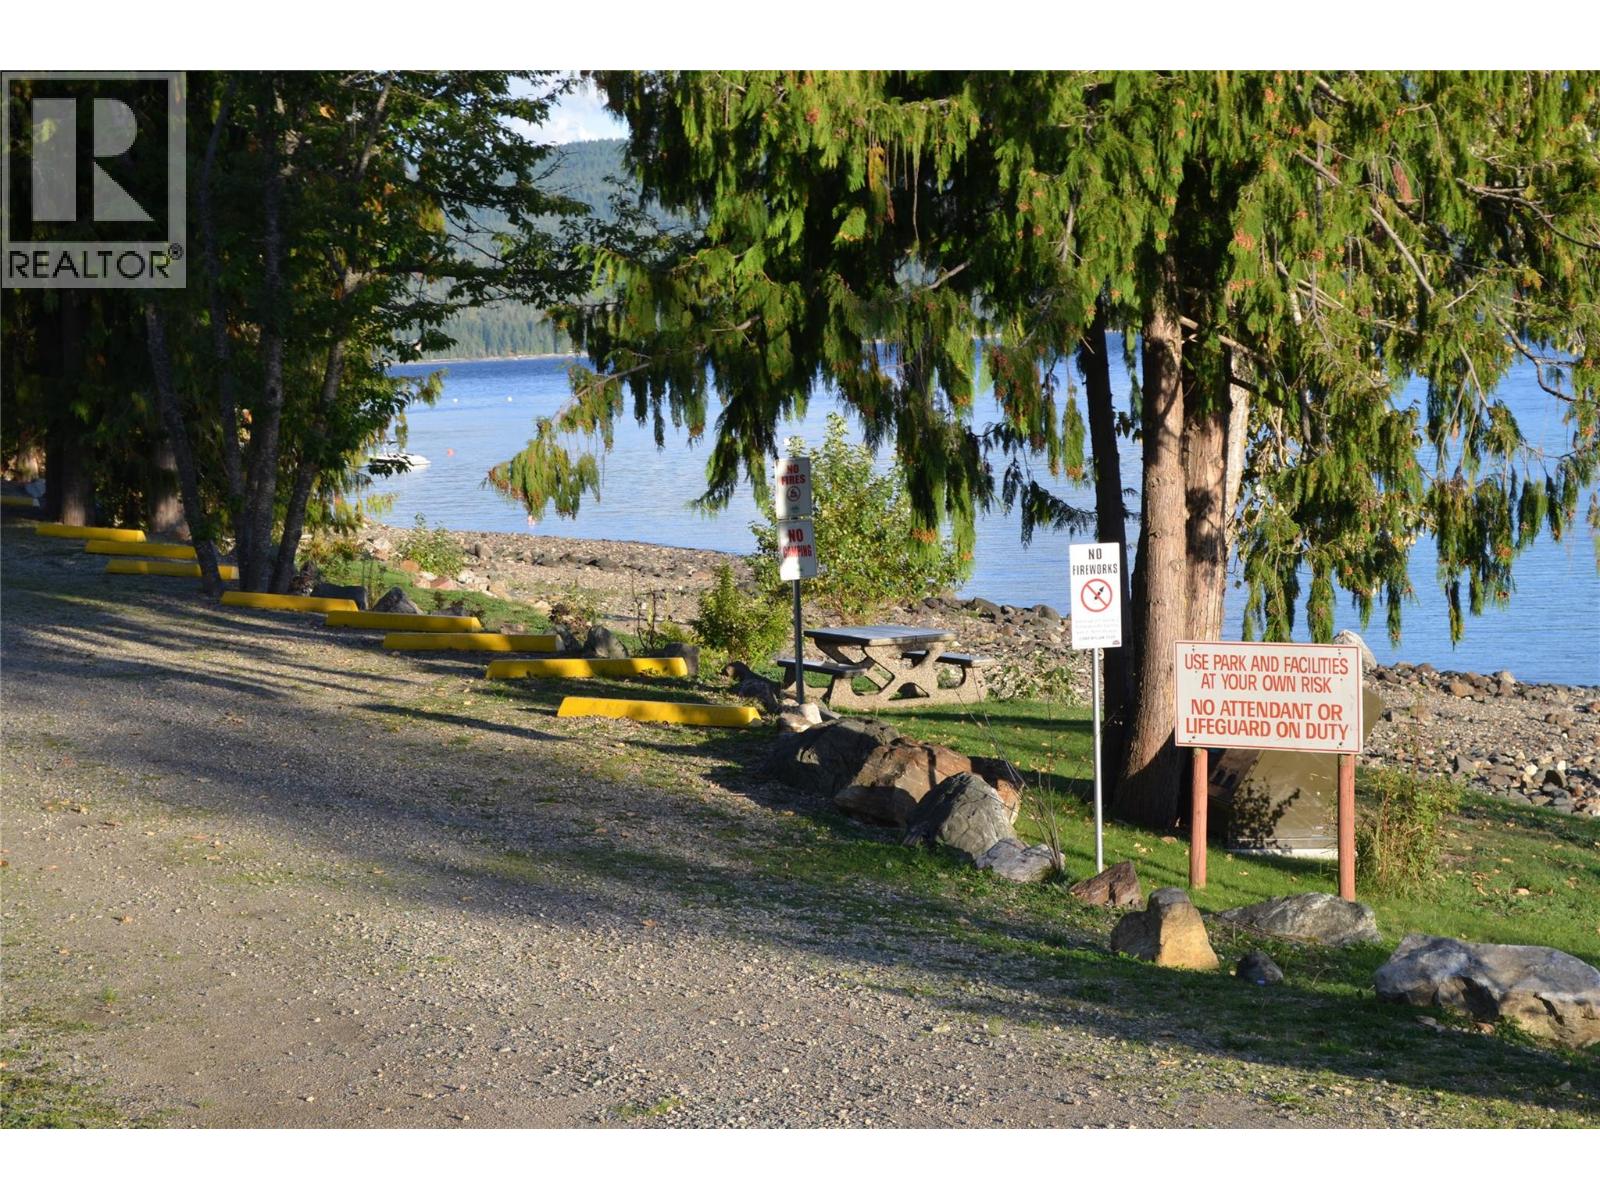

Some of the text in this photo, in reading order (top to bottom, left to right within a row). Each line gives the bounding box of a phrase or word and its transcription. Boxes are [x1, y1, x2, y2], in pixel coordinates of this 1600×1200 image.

[787, 464, 799, 474] NO
[781, 475, 806, 485] FIRES
[788, 529, 804, 542] NO
[783, 545, 812, 558] CAMPING
[1088, 548, 1102, 560] NO
[1072, 564, 1118, 576] FIREWORKS
[1184, 653, 1349, 675] USE PARK AND FACILITIES
[1200, 673, 1332, 693] AT YOUR OWN RISK
[1191, 699, 1343, 721] NO ATTENDANT OR
[1185, 717, 1349, 740] LIFEGUARD ON DUTY
